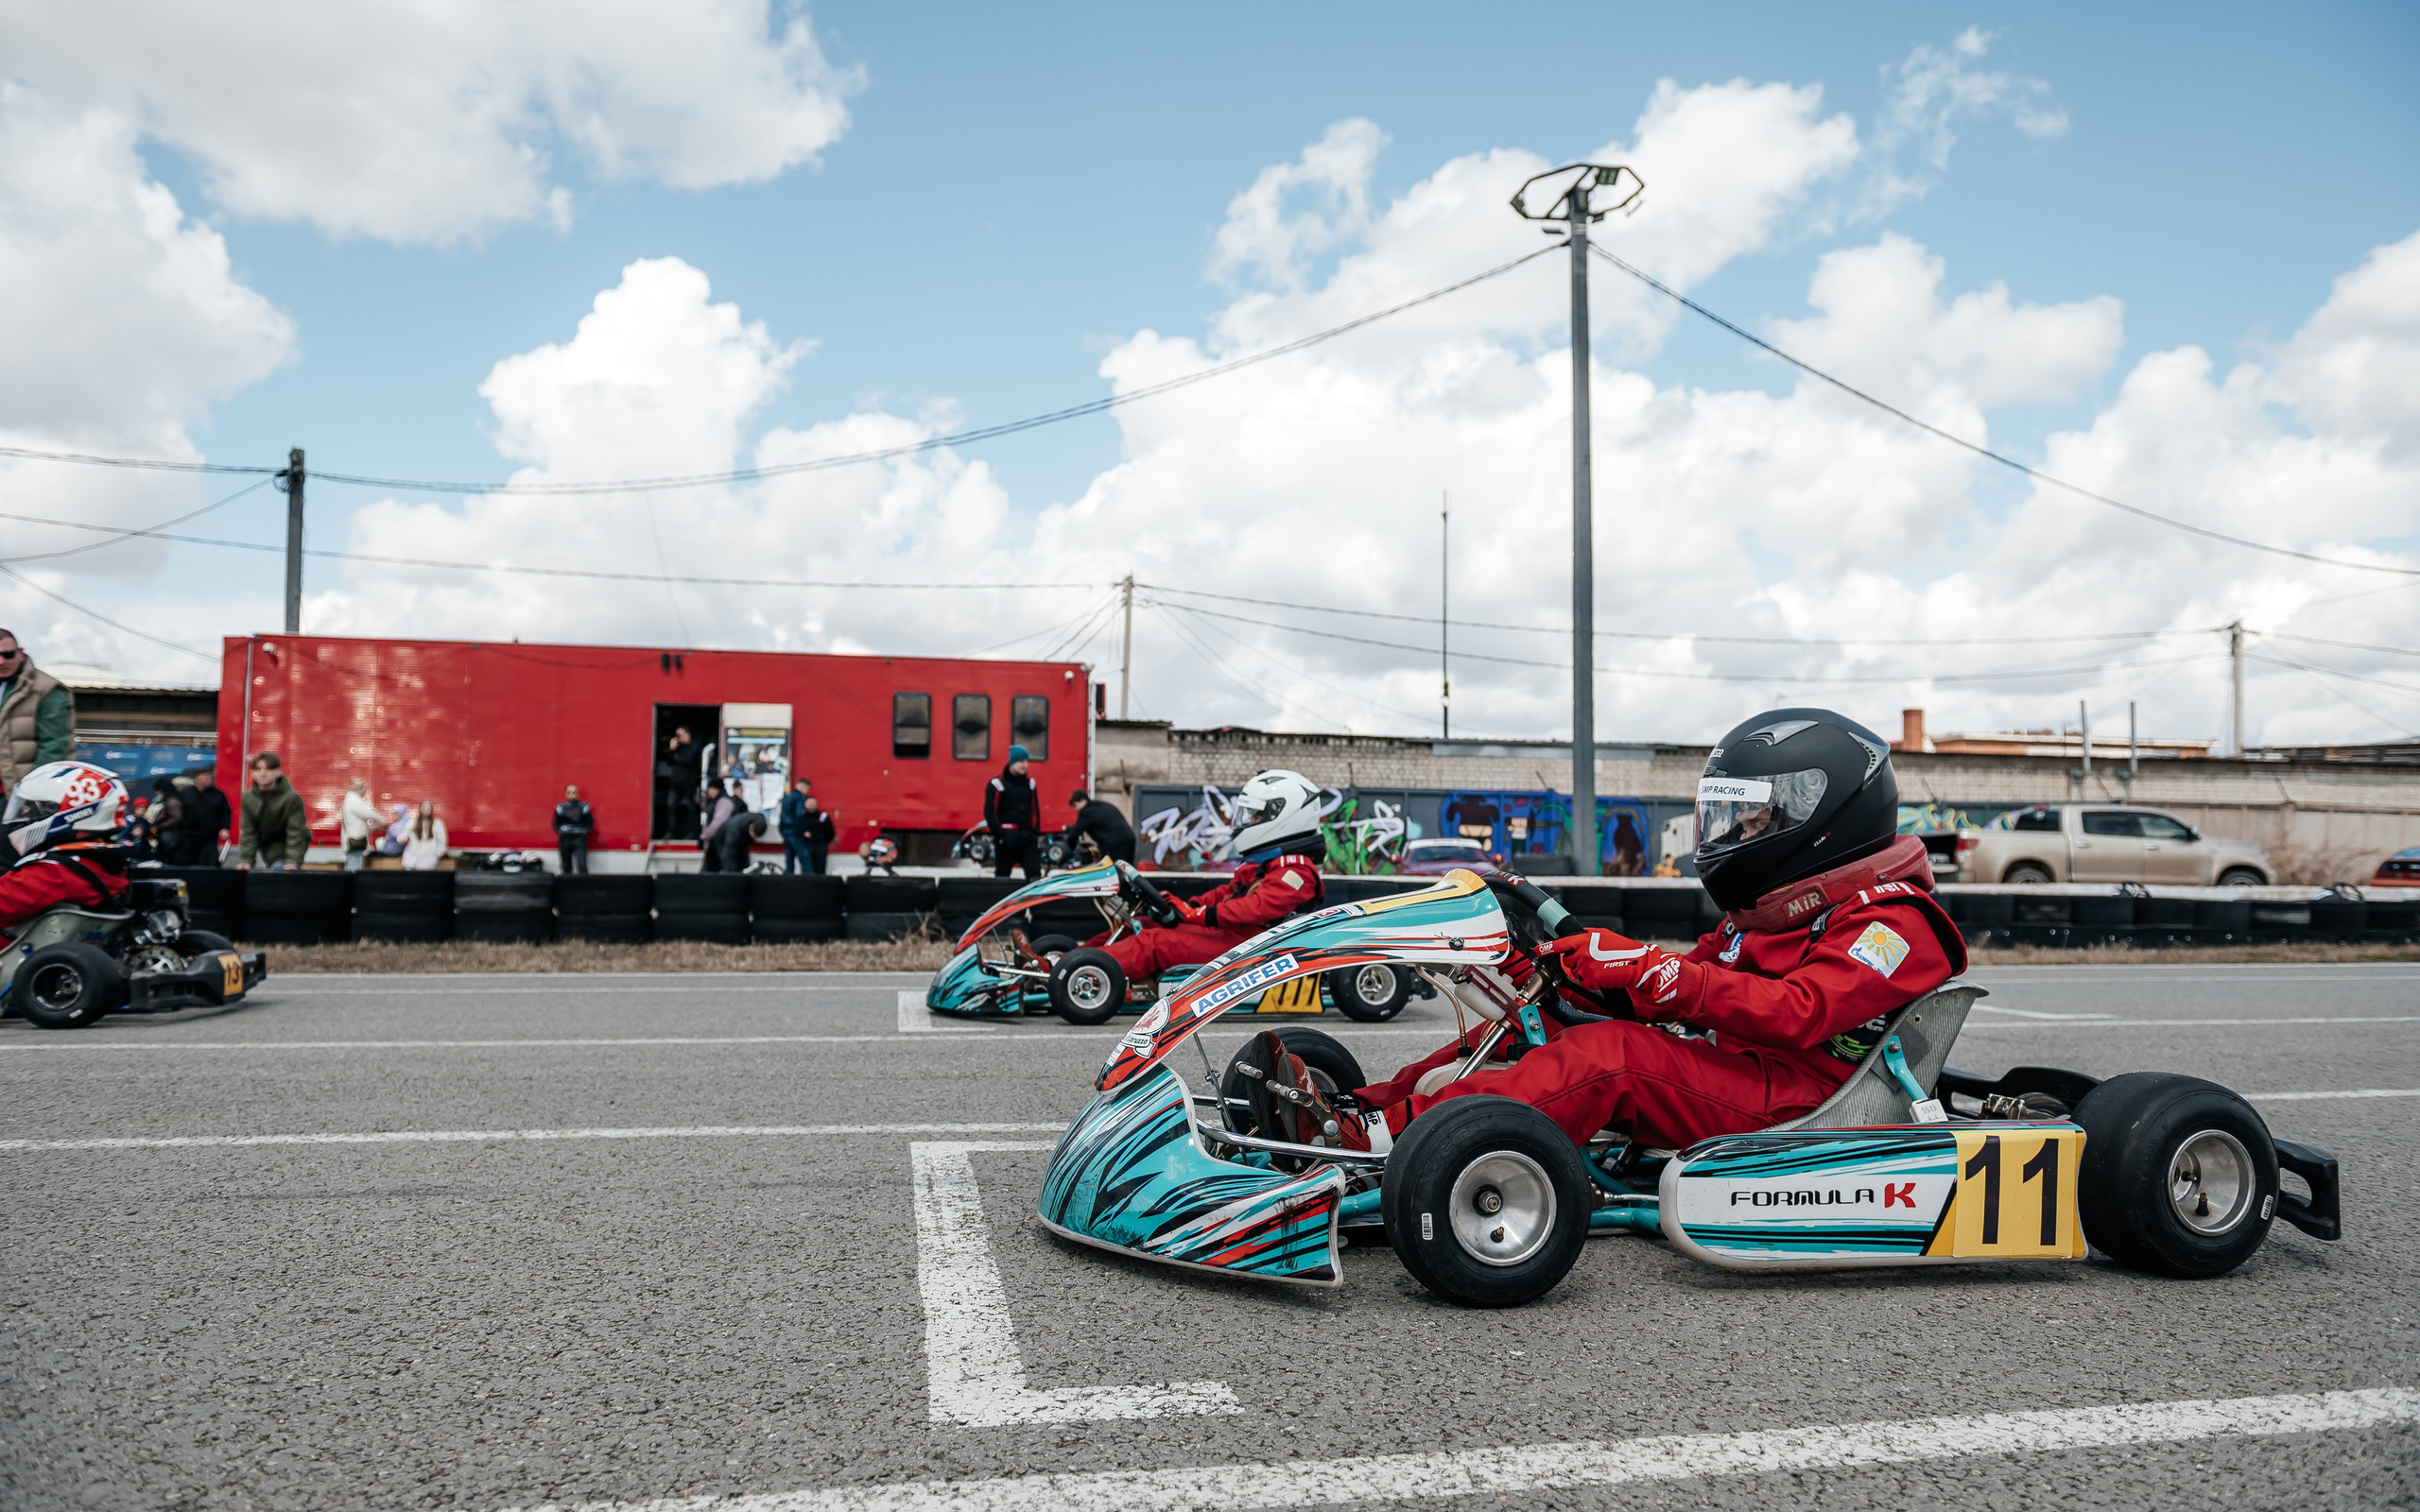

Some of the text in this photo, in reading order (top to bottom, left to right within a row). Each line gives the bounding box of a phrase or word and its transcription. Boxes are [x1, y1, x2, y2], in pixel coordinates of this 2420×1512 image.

[65, 778, 101, 807] 93
[1713, 785, 1746, 797] RACING
[1538, 943, 1554, 954] OMP
[1198, 957, 1294, 1014] AGRIFER
[1657, 959, 1682, 988] OMP
[1365, 1111, 1379, 1125] MP
[1730, 1182, 1916, 1209] FORMULA K
[1965, 1135, 2059, 1246] 11
